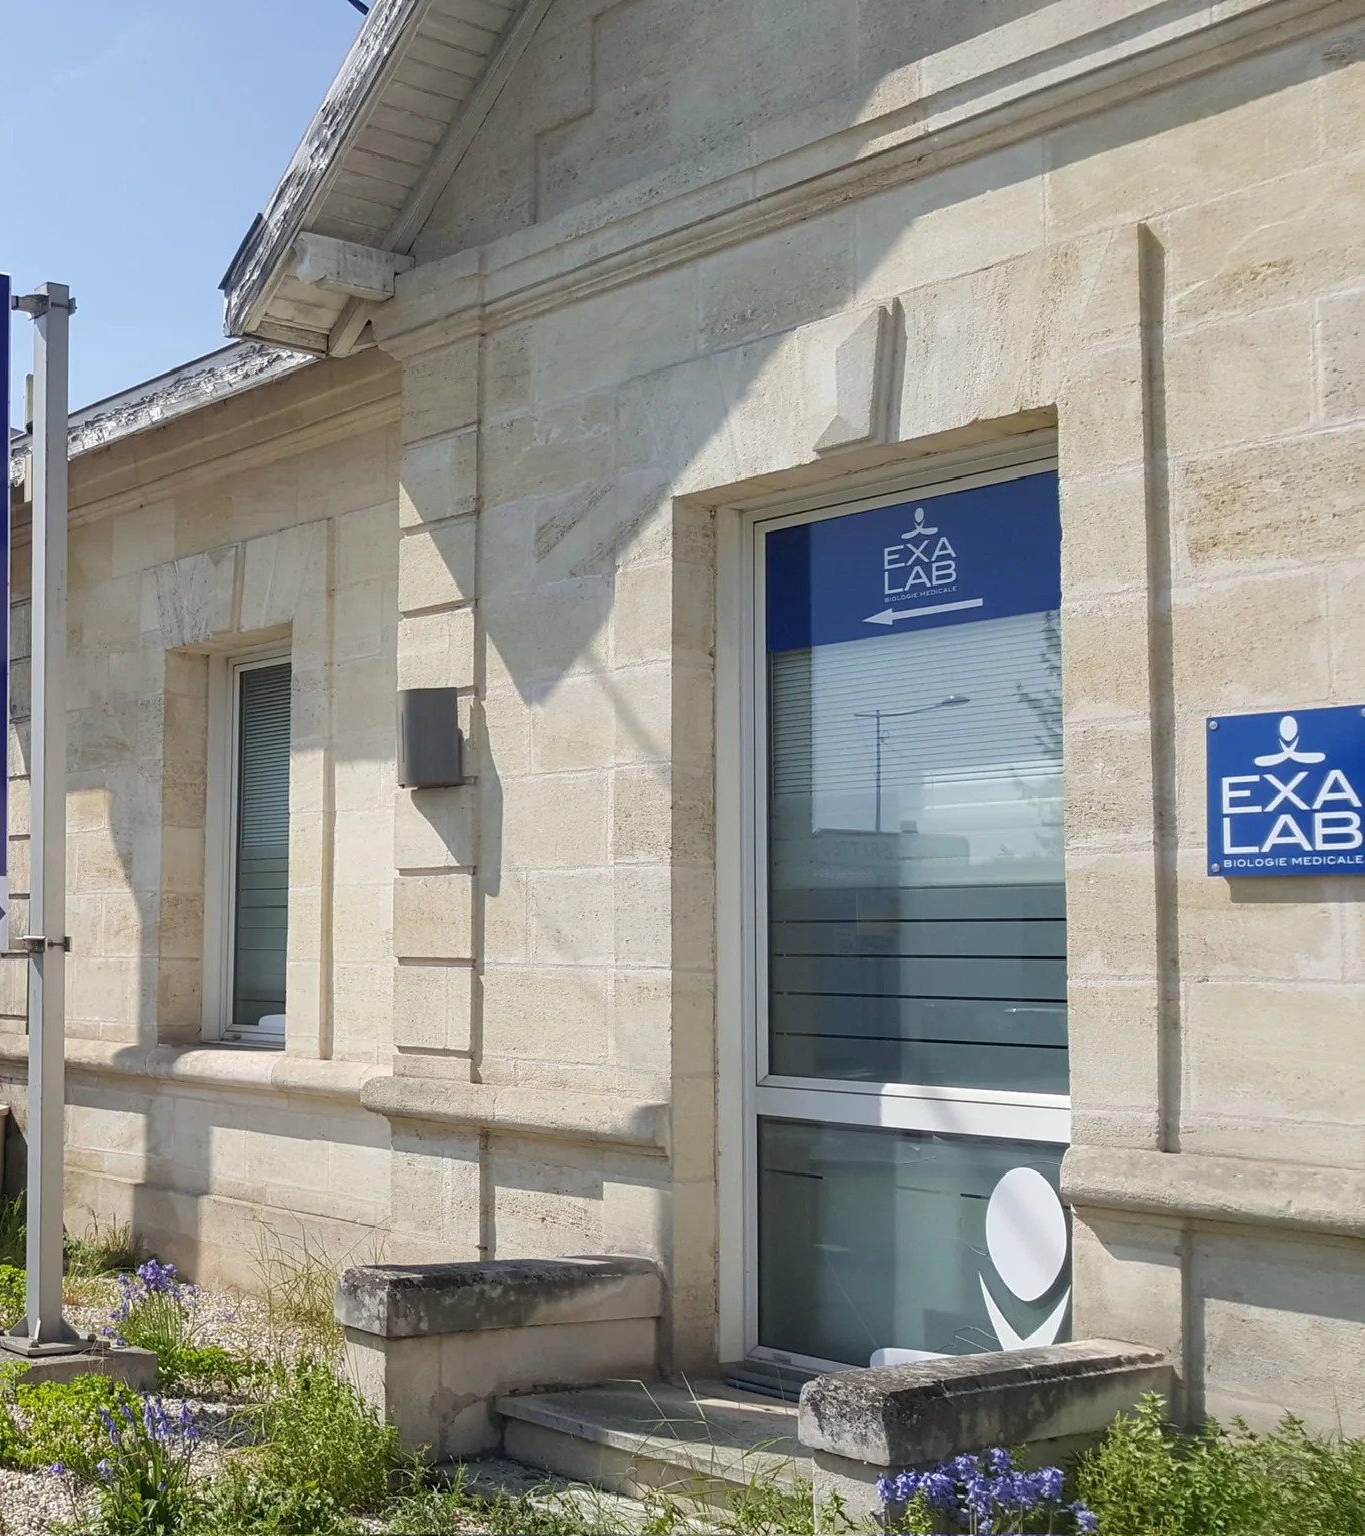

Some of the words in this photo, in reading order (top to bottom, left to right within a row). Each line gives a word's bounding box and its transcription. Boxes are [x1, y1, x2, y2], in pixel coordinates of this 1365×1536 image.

[883, 536, 957, 570] EXA
[884, 559, 957, 595] LAB
[884, 591, 919, 603] BIOLOGIE
[919, 585, 958, 598] MEDICALE
[1222, 769, 1363, 815] EXA
[1223, 810, 1364, 855] LAB
[1223, 857, 1288, 869] BIOLOGIE
[1291, 854, 1365, 867] MEDICALE
